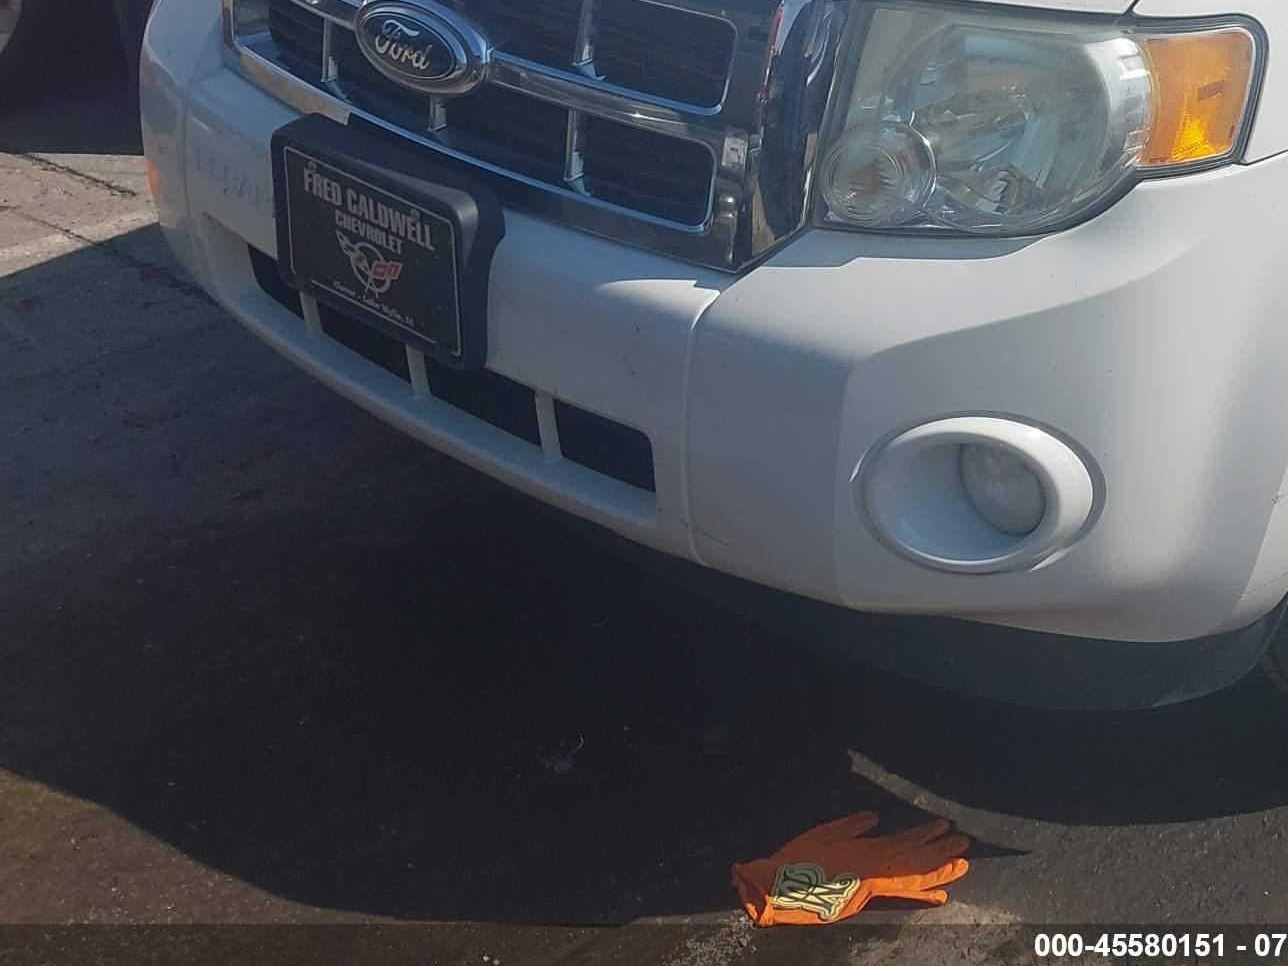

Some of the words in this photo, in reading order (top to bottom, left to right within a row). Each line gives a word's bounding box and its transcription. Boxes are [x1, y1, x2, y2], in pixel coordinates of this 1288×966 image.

[375, 19, 433, 70] Ford
[303, 170, 343, 207] FRED
[346, 188, 435, 251] CALDWELL
[335, 209, 404, 255] CHEVROLET
